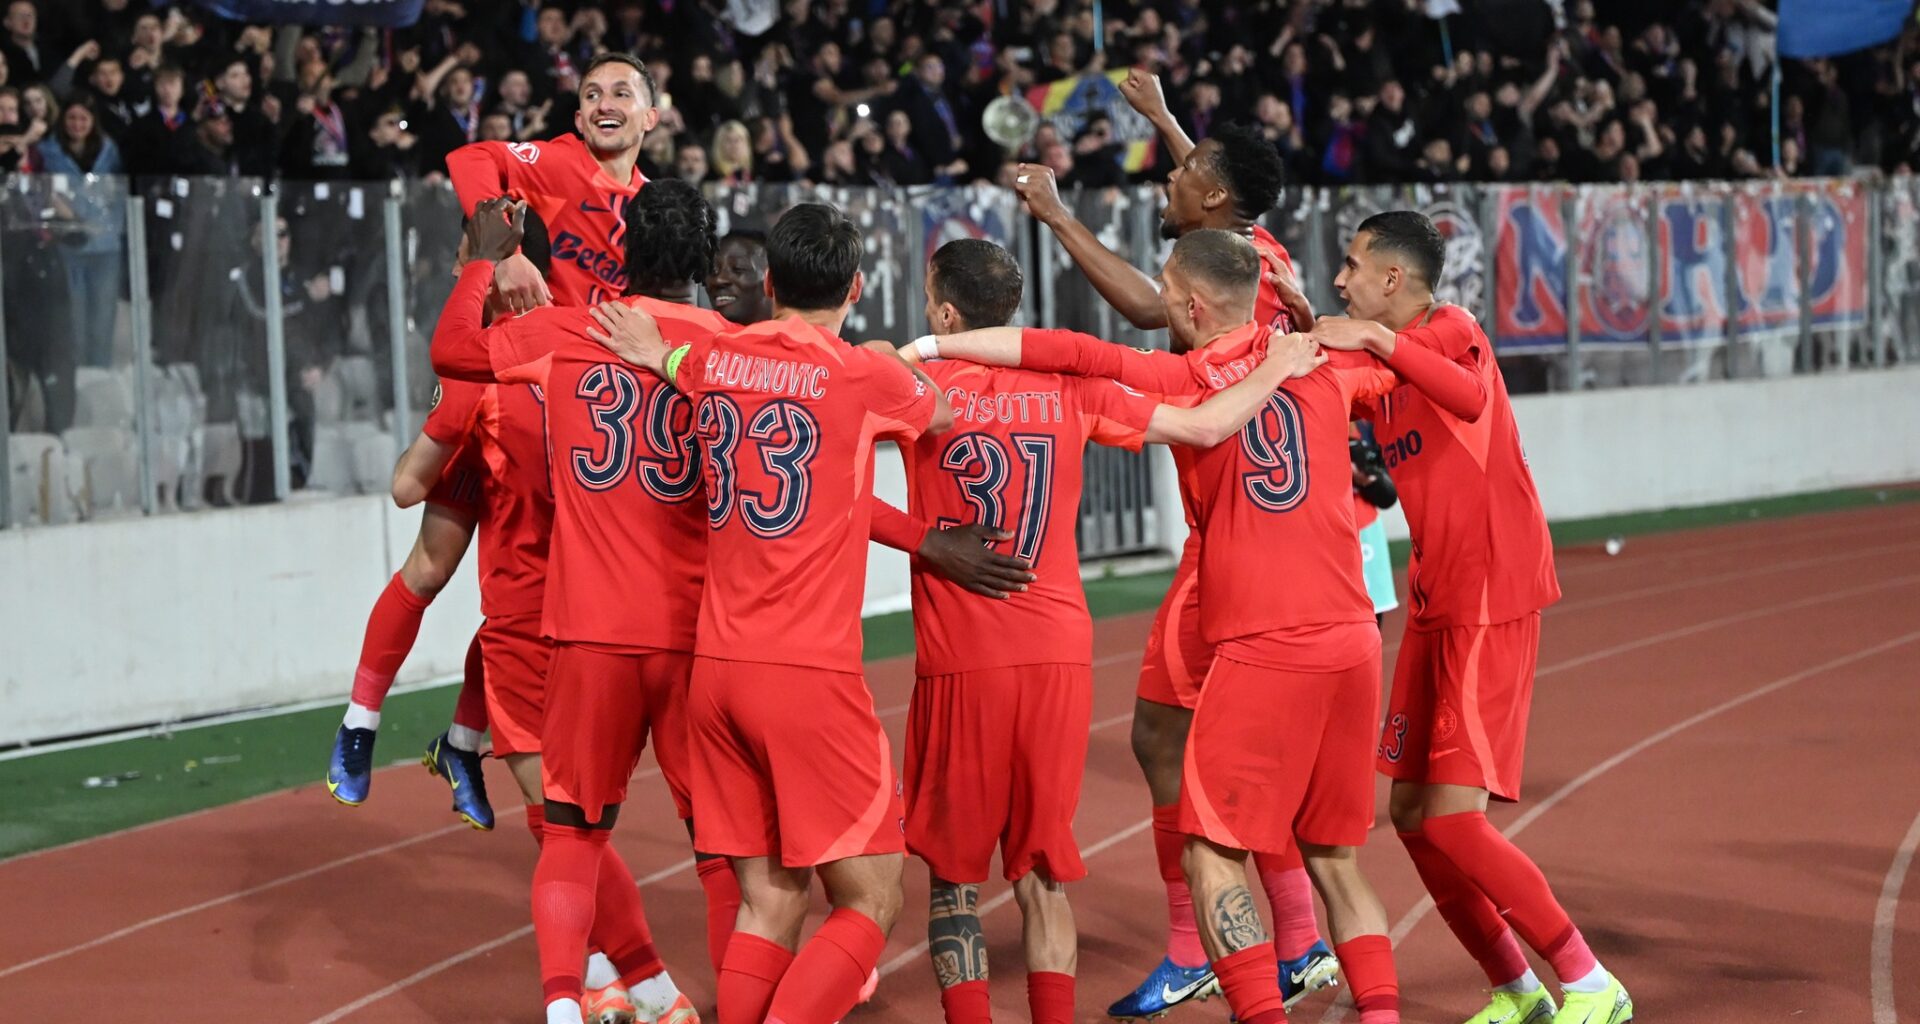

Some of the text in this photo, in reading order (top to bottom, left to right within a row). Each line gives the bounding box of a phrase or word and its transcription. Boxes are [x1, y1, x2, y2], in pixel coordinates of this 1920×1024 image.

[570, 363, 700, 505] 39
[703, 350, 830, 400] RADUNOVIC
[946, 386, 1064, 424] CISOTTI
[695, 391, 823, 539] 33
[936, 431, 1057, 570] 31
[1237, 385, 1311, 513] 9
